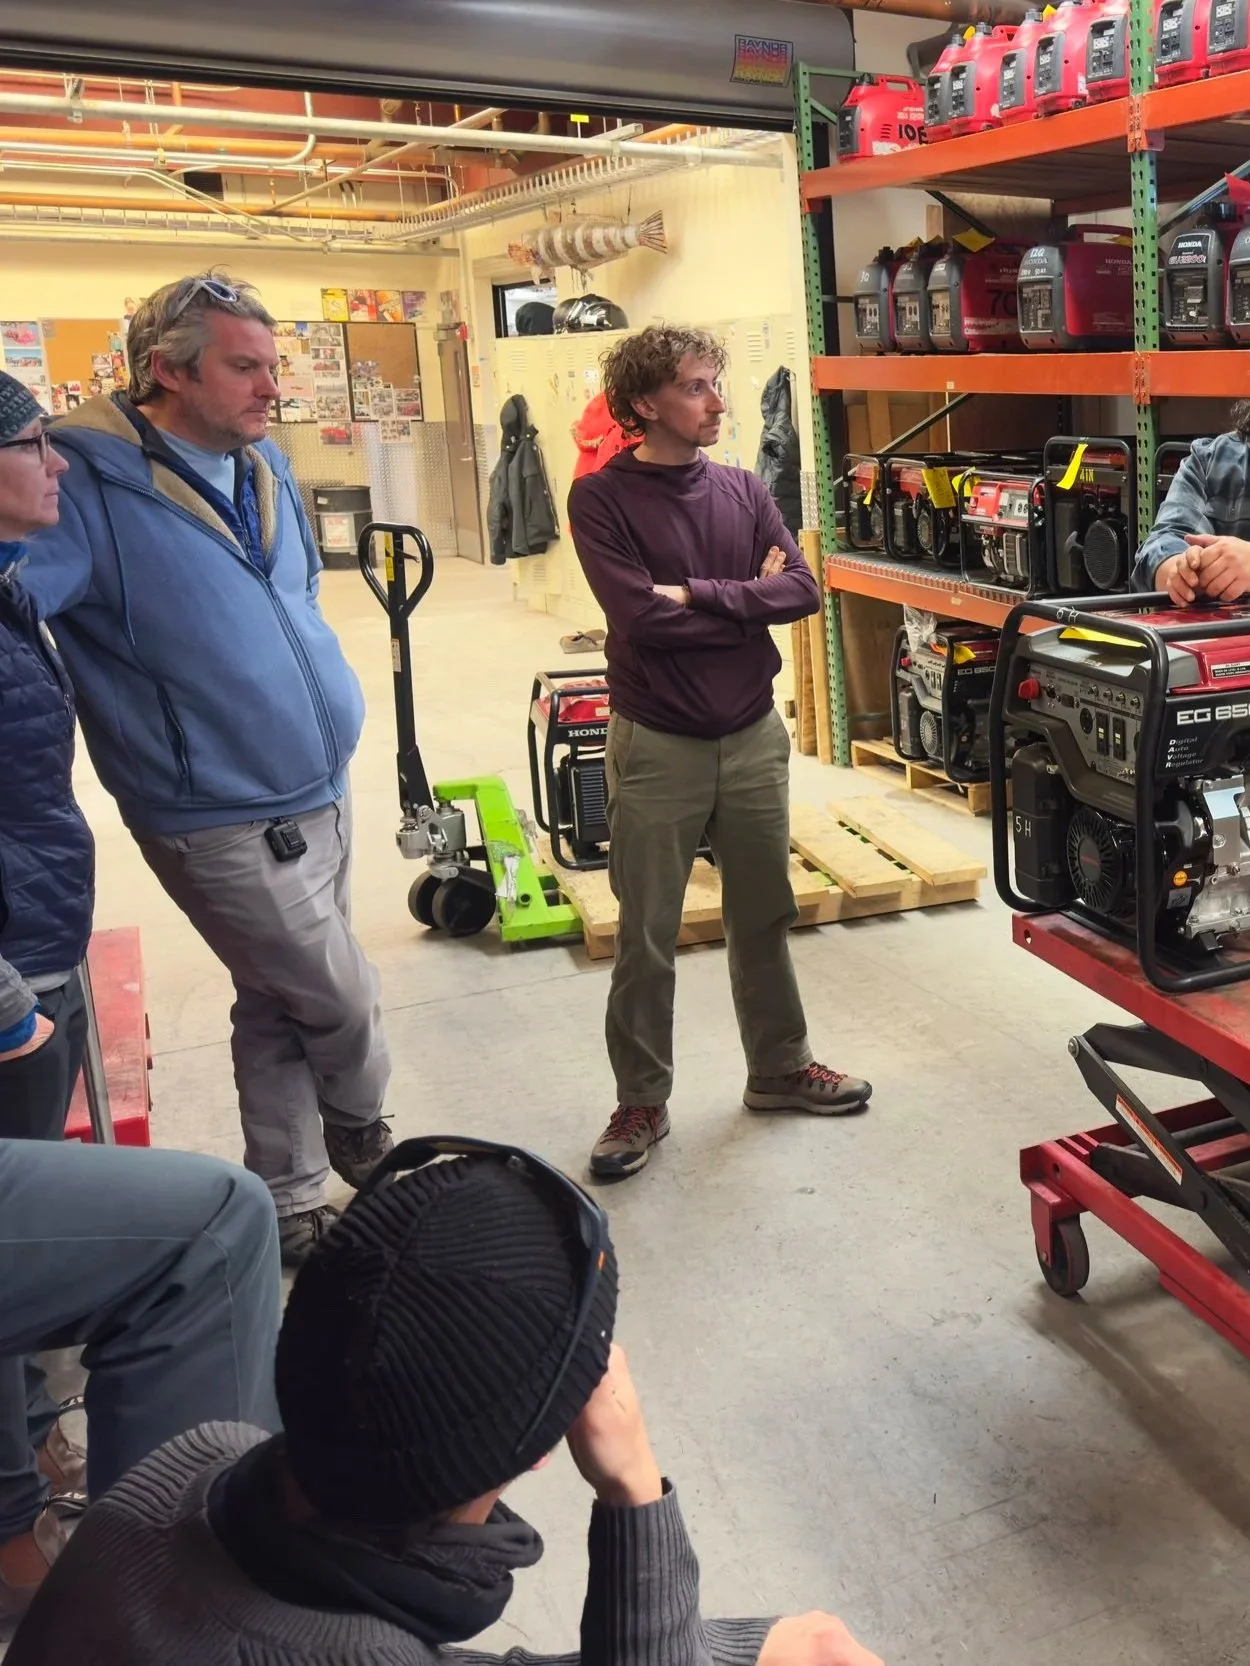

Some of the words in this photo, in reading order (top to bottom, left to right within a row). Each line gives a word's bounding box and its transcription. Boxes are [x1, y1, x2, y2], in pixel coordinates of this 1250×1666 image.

[1177, 240, 1202, 249] HONDA
[1079, 469, 1095, 483] 41N
[1177, 709, 1212, 726] EG
[568, 727, 608, 738] HOND
[1169, 736, 1198, 746] Digital
[1167, 752, 1197, 761] Voltage
[1165, 759, 1204, 768] Regulator
